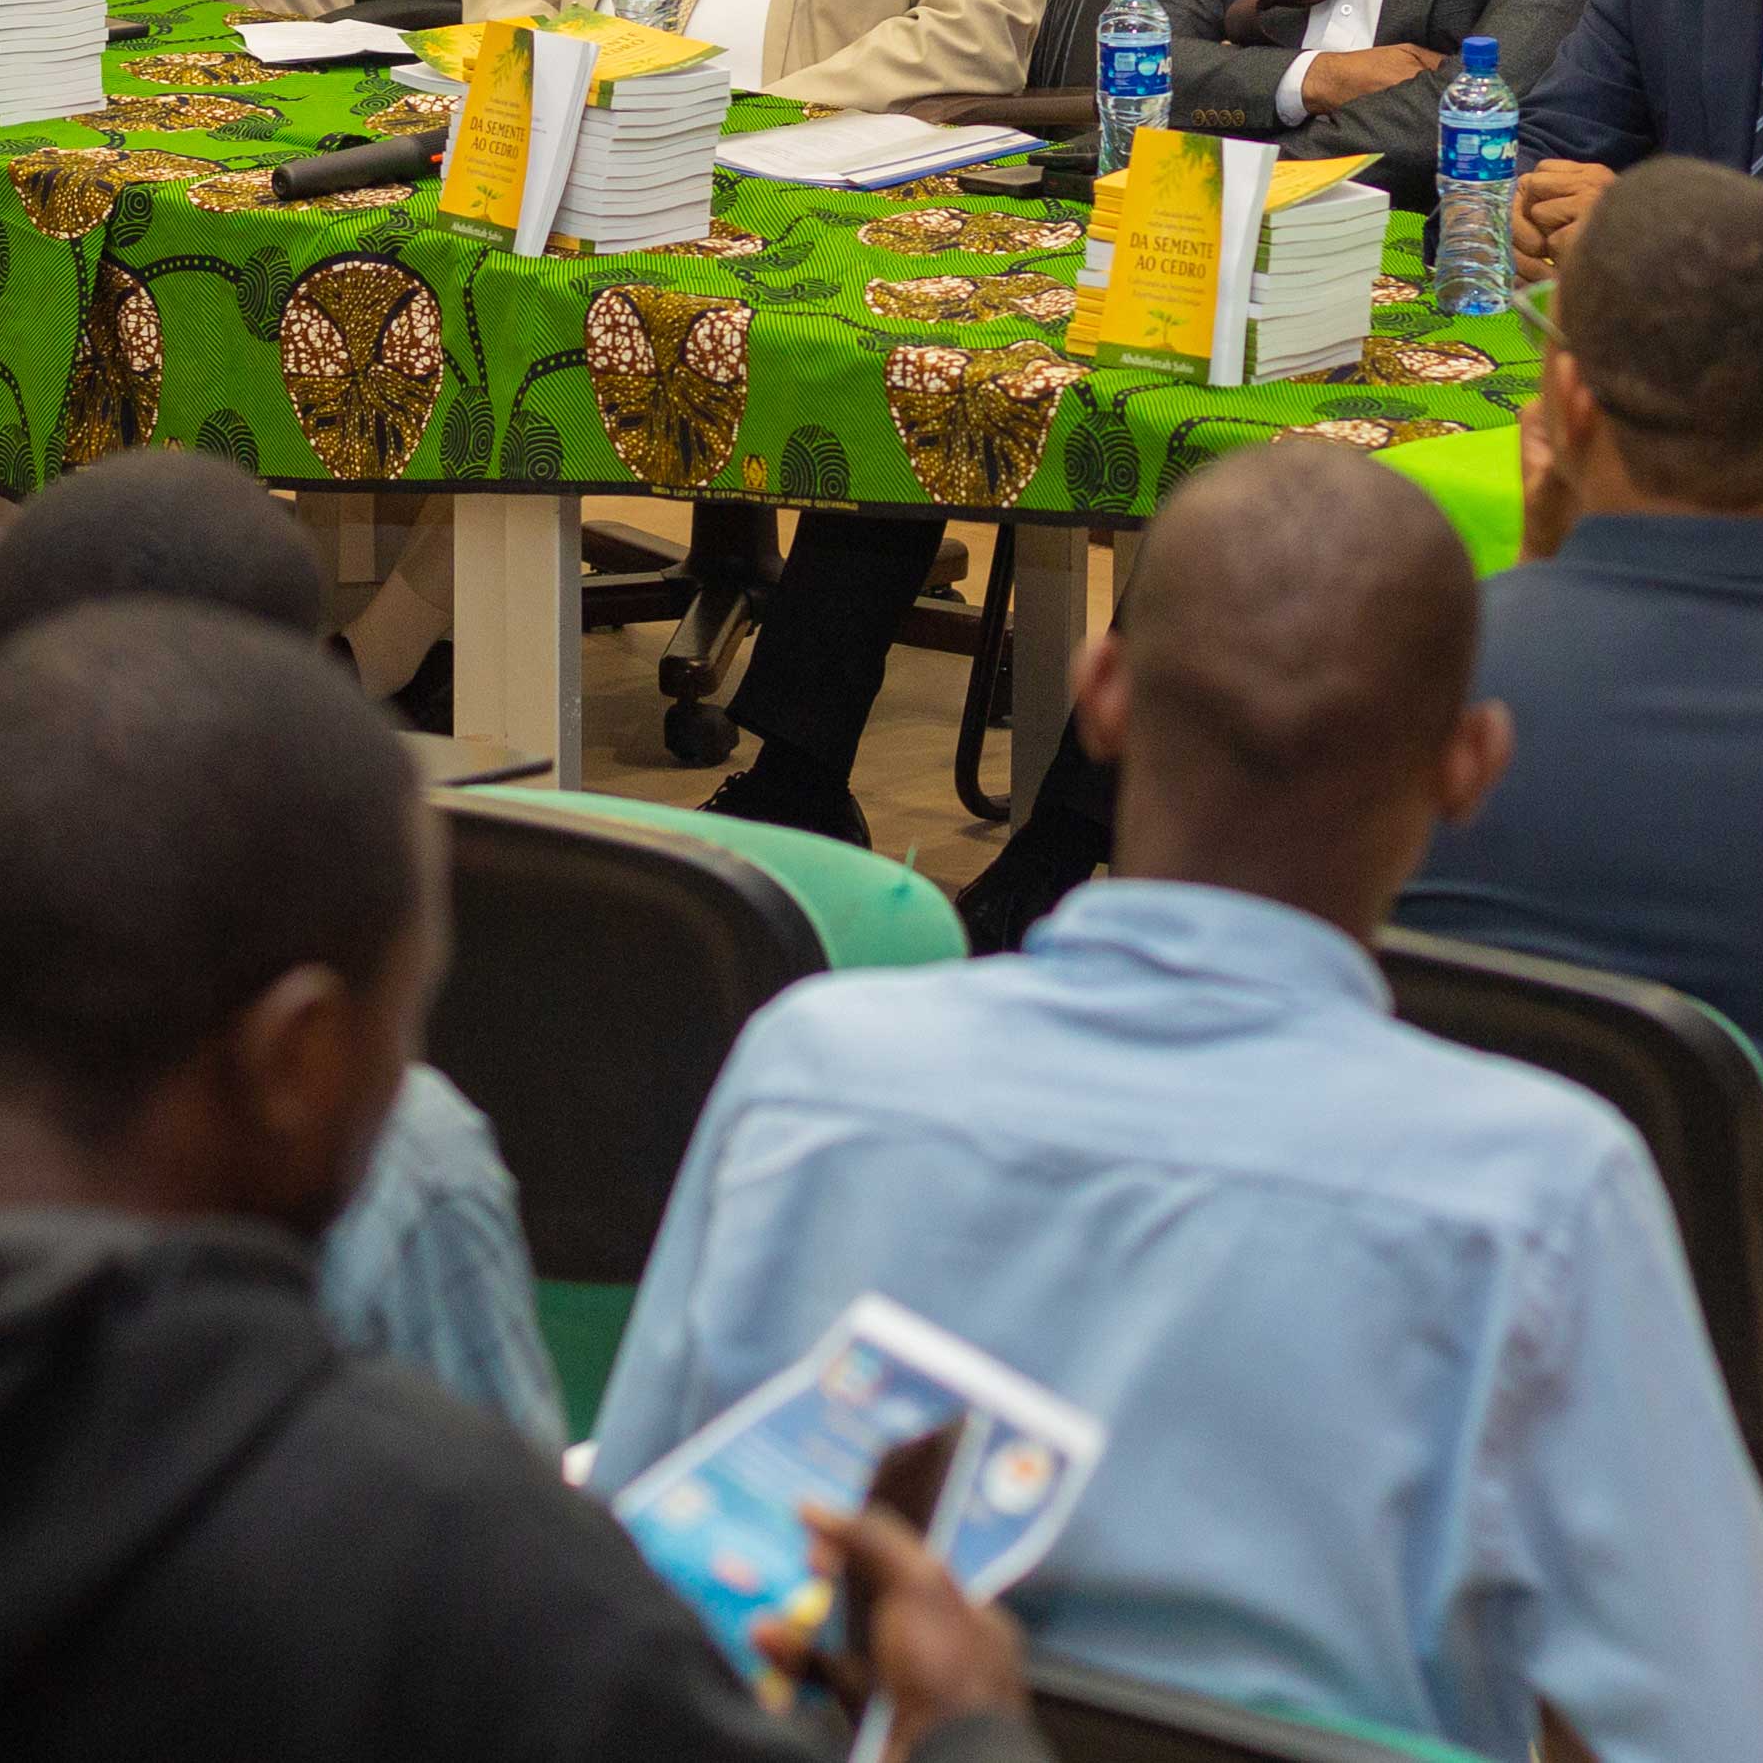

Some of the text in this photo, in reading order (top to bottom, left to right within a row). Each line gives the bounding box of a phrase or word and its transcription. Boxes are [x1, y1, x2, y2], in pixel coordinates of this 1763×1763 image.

[470, 116, 526, 143] DA SEMENTE
[471, 137, 519, 160] AO CEDRO
[1130, 232, 1215, 260] DA SEMENTE
[1135, 254, 1207, 280] AO CEDRO
